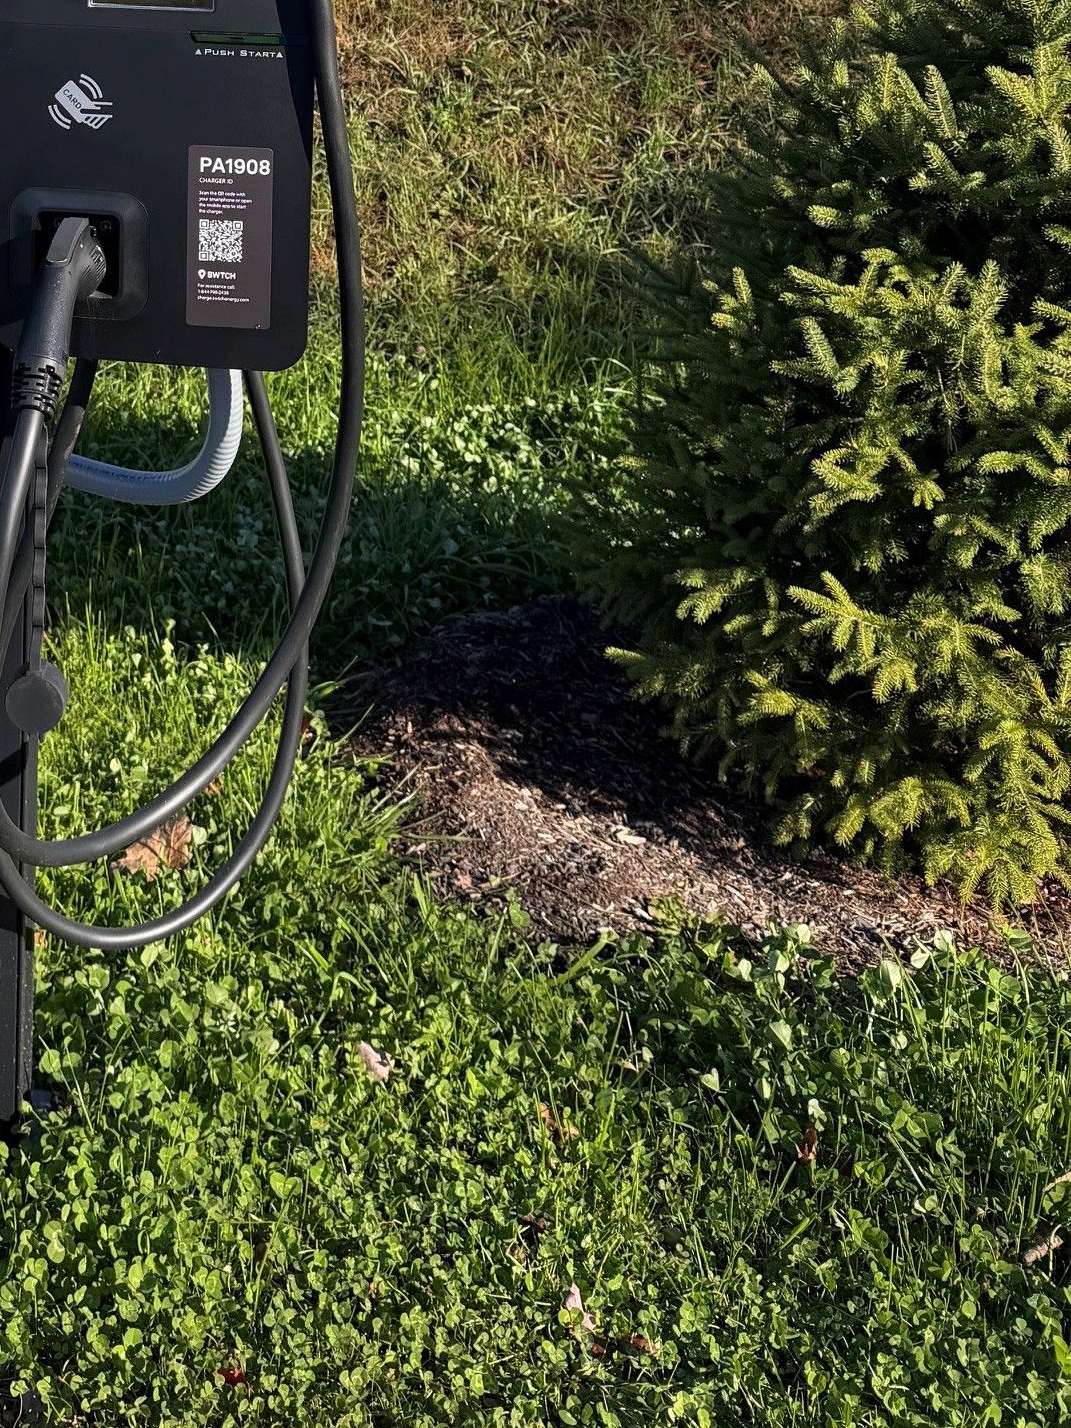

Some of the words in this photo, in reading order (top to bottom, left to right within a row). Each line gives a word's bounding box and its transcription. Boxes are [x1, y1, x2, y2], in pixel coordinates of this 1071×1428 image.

[62, 88, 83, 110] CARD
[199, 156, 271, 176] PA1908
[207, 270, 237, 280] SWTCH
